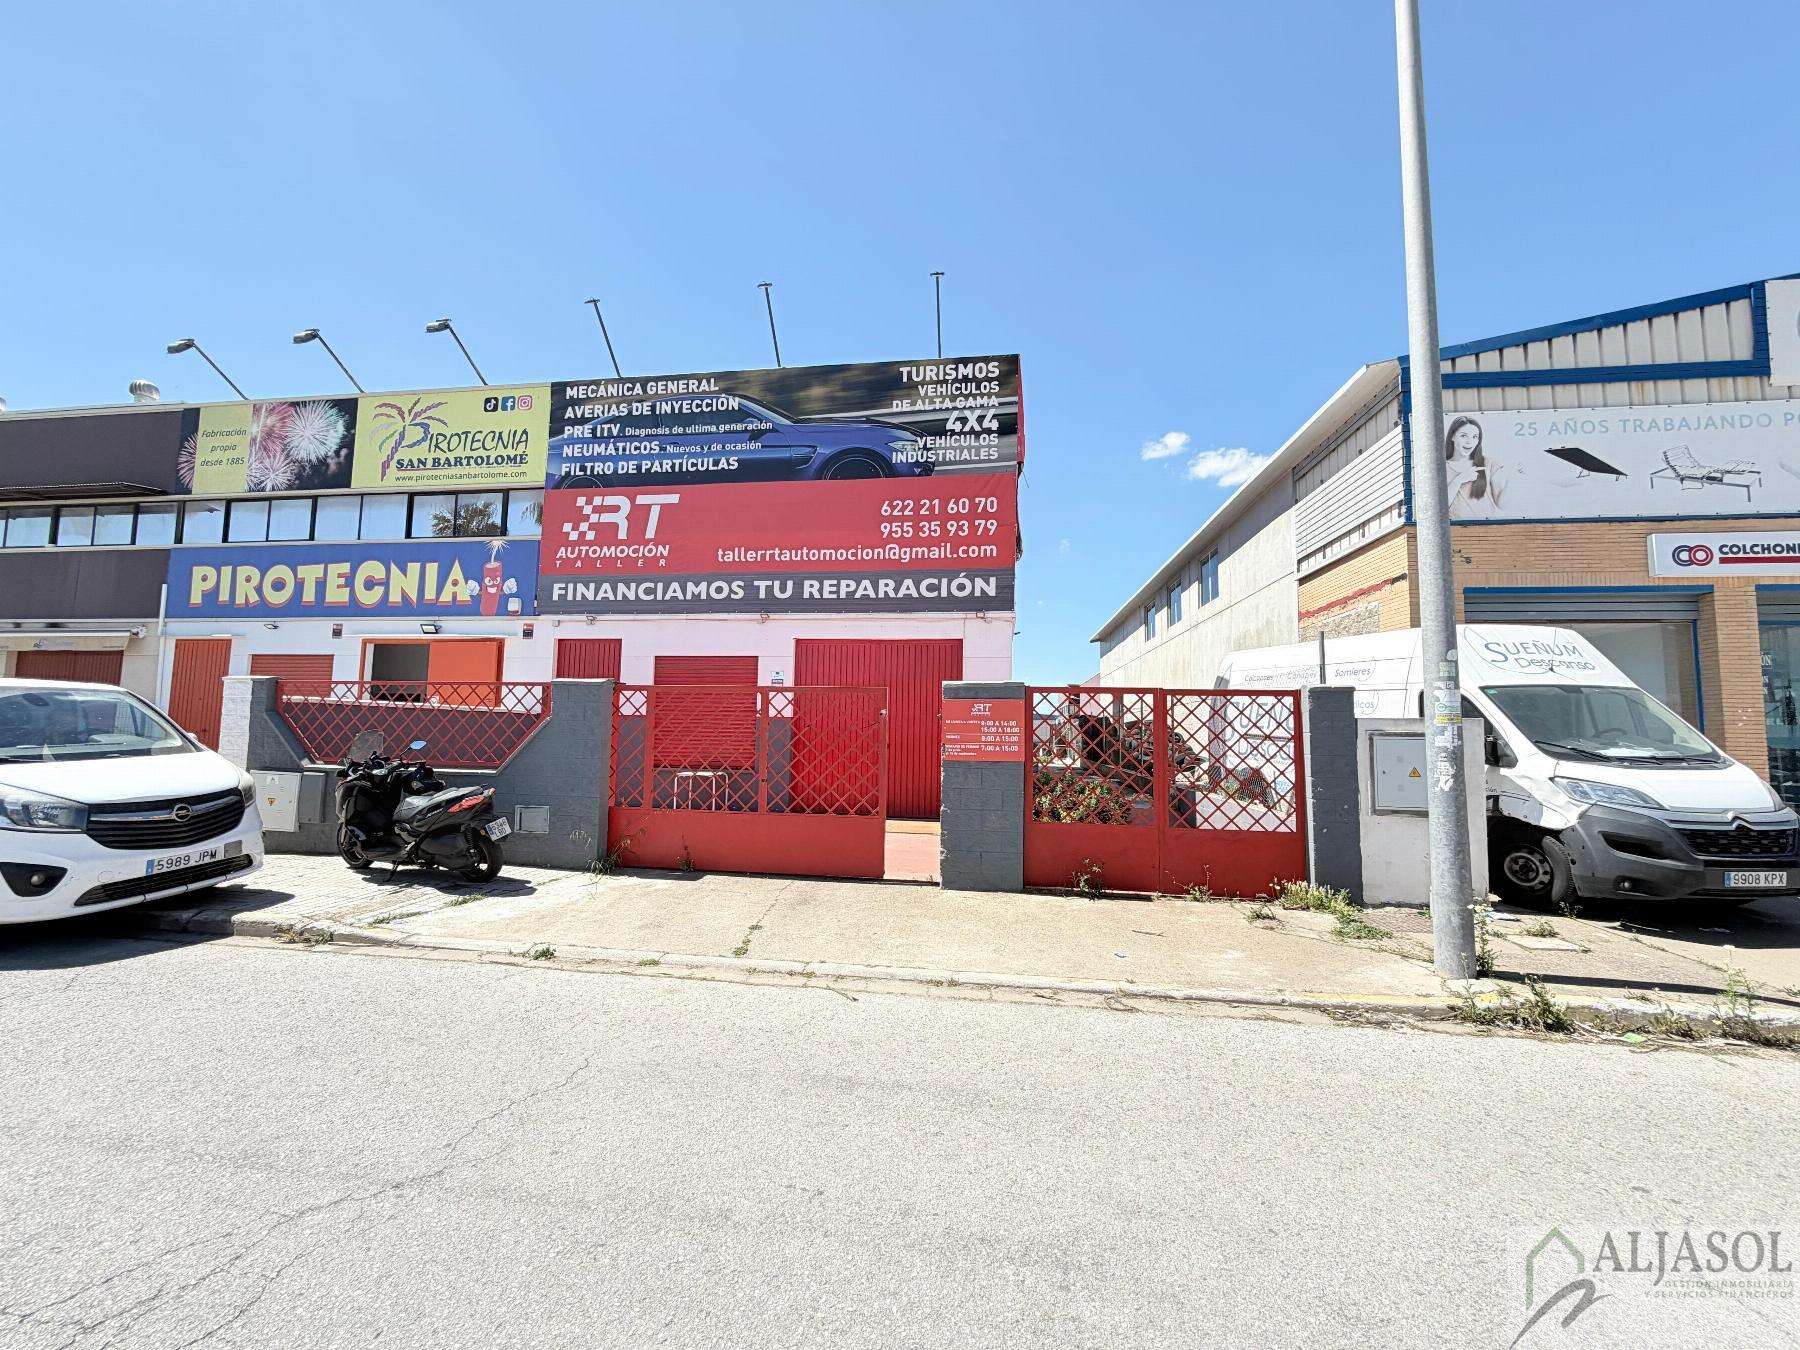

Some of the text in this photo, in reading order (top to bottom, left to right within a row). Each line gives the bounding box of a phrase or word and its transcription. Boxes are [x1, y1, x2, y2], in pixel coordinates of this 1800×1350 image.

[900, 361, 999, 382] TURISMOS
[566, 378, 719, 399] MECÁNICA GENERAL
[918, 380, 999, 396] VEHÍCULOS
[564, 394, 738, 419] AVERIAS DE INYECCIÓN
[893, 395, 999, 412] DE ALTA GAMA
[564, 425, 593, 438] PRE
[625, 426, 670, 437] Diagnosis
[672, 425, 684, 434] de
[686, 423, 716, 433] ultima
[719, 421, 773, 433] generación
[946, 409, 999, 432] 4X4
[1514, 421, 1537, 436] 25
[1548, 417, 1609, 436] AÑOS
[1619, 413, 1772, 433] TRABAJANDO
[201, 428, 247, 438] Fabricación
[917, 432, 998, 448] VEHÍCULOS
[210, 443, 237, 453] propia
[666, 444, 701, 454] Nuevos
[702, 444, 709, 454] y
[711, 443, 723, 451] de
[724, 441, 762, 450] ocasión
[892, 447, 998, 463] INDUSTRIALES
[200, 457, 245, 467] desde 1885
[396, 451, 528, 469] SAN BARTOLOMÉ
[561, 455, 738, 476] FILTRO DE PARTÍCULAS
[395, 470, 527, 482] www.pirotecniasanbartolome.com
[880, 497, 998, 516] 622 21 60 70
[575, 494, 680, 540] RT
[880, 519, 998, 539] 955 35 93 79
[555, 542, 670, 558] AUTOMOCIÓN
[717, 543, 997, 562] tallerrtautomocion@gmail.com
[189, 554, 473, 608] PIROTECNIA
[552, 572, 996, 600] FINANCIAMOS TU REPARACIÓN
[1485, 640, 1584, 663] SUEÑUM
[1334, 668, 1371, 678] Somieres
[1514, 657, 1596, 671] Descanso
[156, 849, 217, 871] 5989 JPM
[1733, 873, 1784, 885] 9908 KPX
